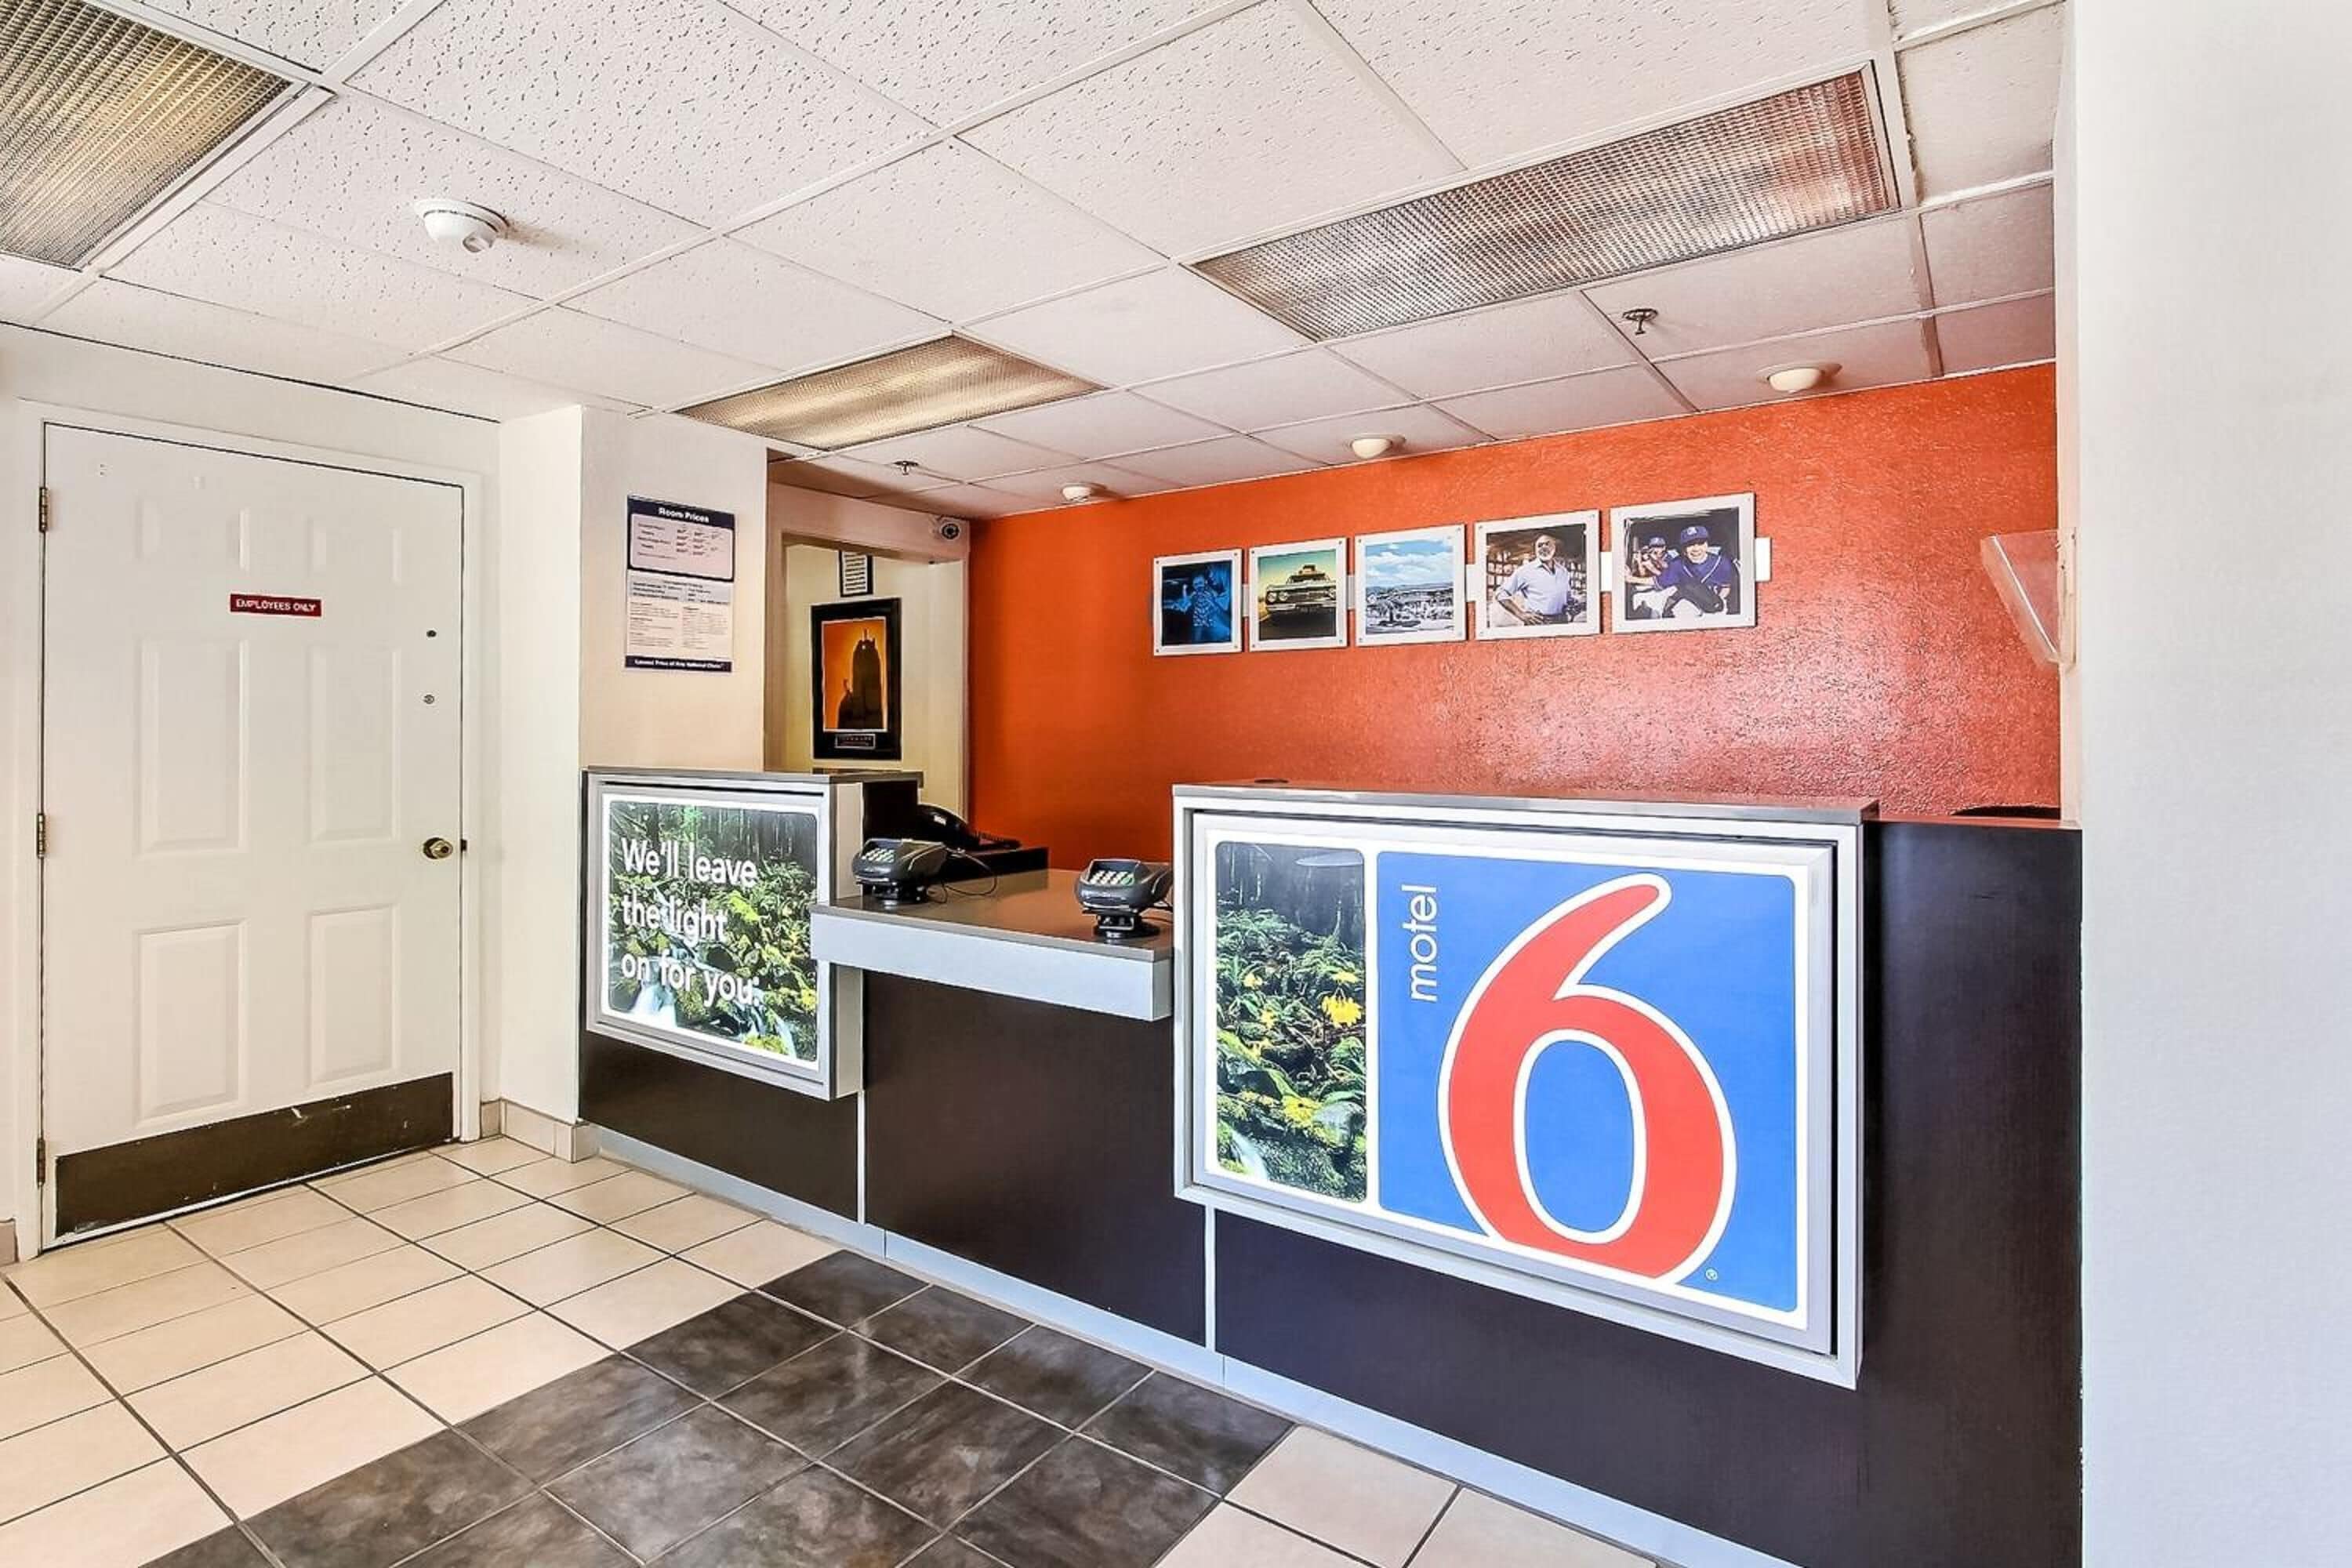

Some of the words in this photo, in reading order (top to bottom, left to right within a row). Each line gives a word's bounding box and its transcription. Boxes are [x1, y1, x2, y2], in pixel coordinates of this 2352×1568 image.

[659, 507, 684, 518] Room
[684, 512, 710, 523] Prices
[236, 598, 291, 611] EMPLOYEES
[292, 602, 316, 612] ONLY
[622, 838, 680, 878] We'll
[688, 841, 758, 888] leave
[621, 891, 661, 929] the
[669, 895, 728, 946] light
[621, 953, 651, 982] on
[659, 949, 697, 992] for
[1401, 884, 1438, 1002] motel
[1438, 873, 1737, 1284] 6
